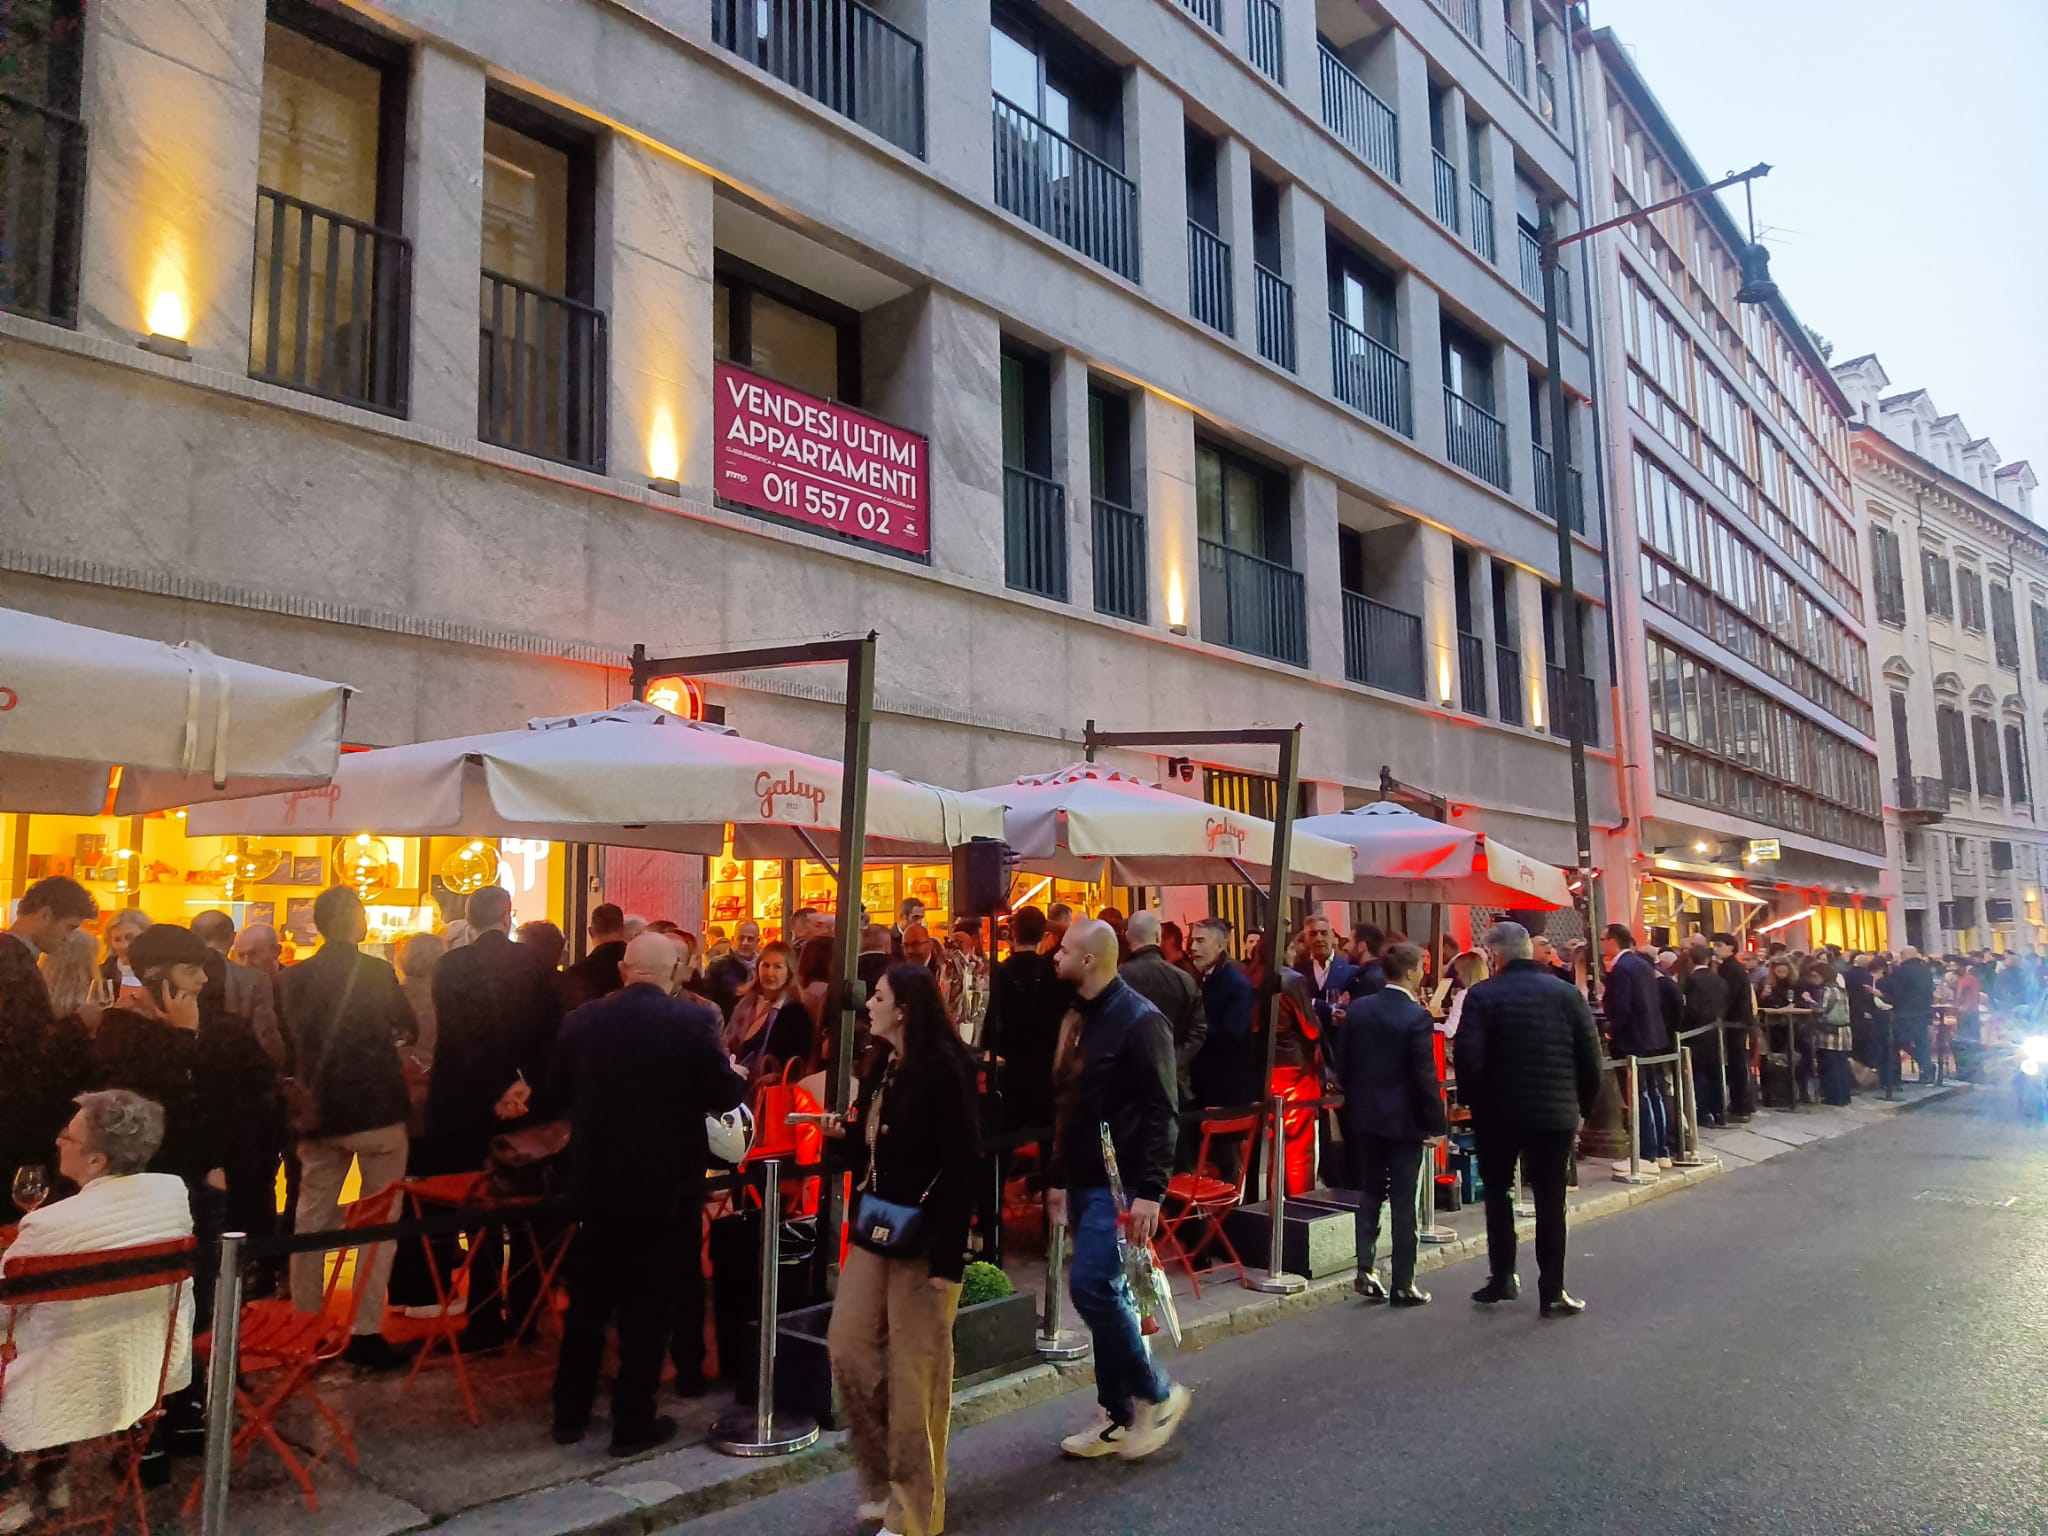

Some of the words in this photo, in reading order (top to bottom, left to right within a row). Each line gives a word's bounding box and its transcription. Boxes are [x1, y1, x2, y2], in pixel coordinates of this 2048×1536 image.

[726, 376, 838, 441] VENDESI
[843, 420, 916, 469] ULTIMI
[727, 414, 917, 499] APPARTAMENTI
[763, 473, 798, 508] 011
[804, 486, 850, 521] 557
[857, 502, 890, 535] 02
[754, 769, 826, 823] Galup
[1206, 816, 1247, 856] Galup
